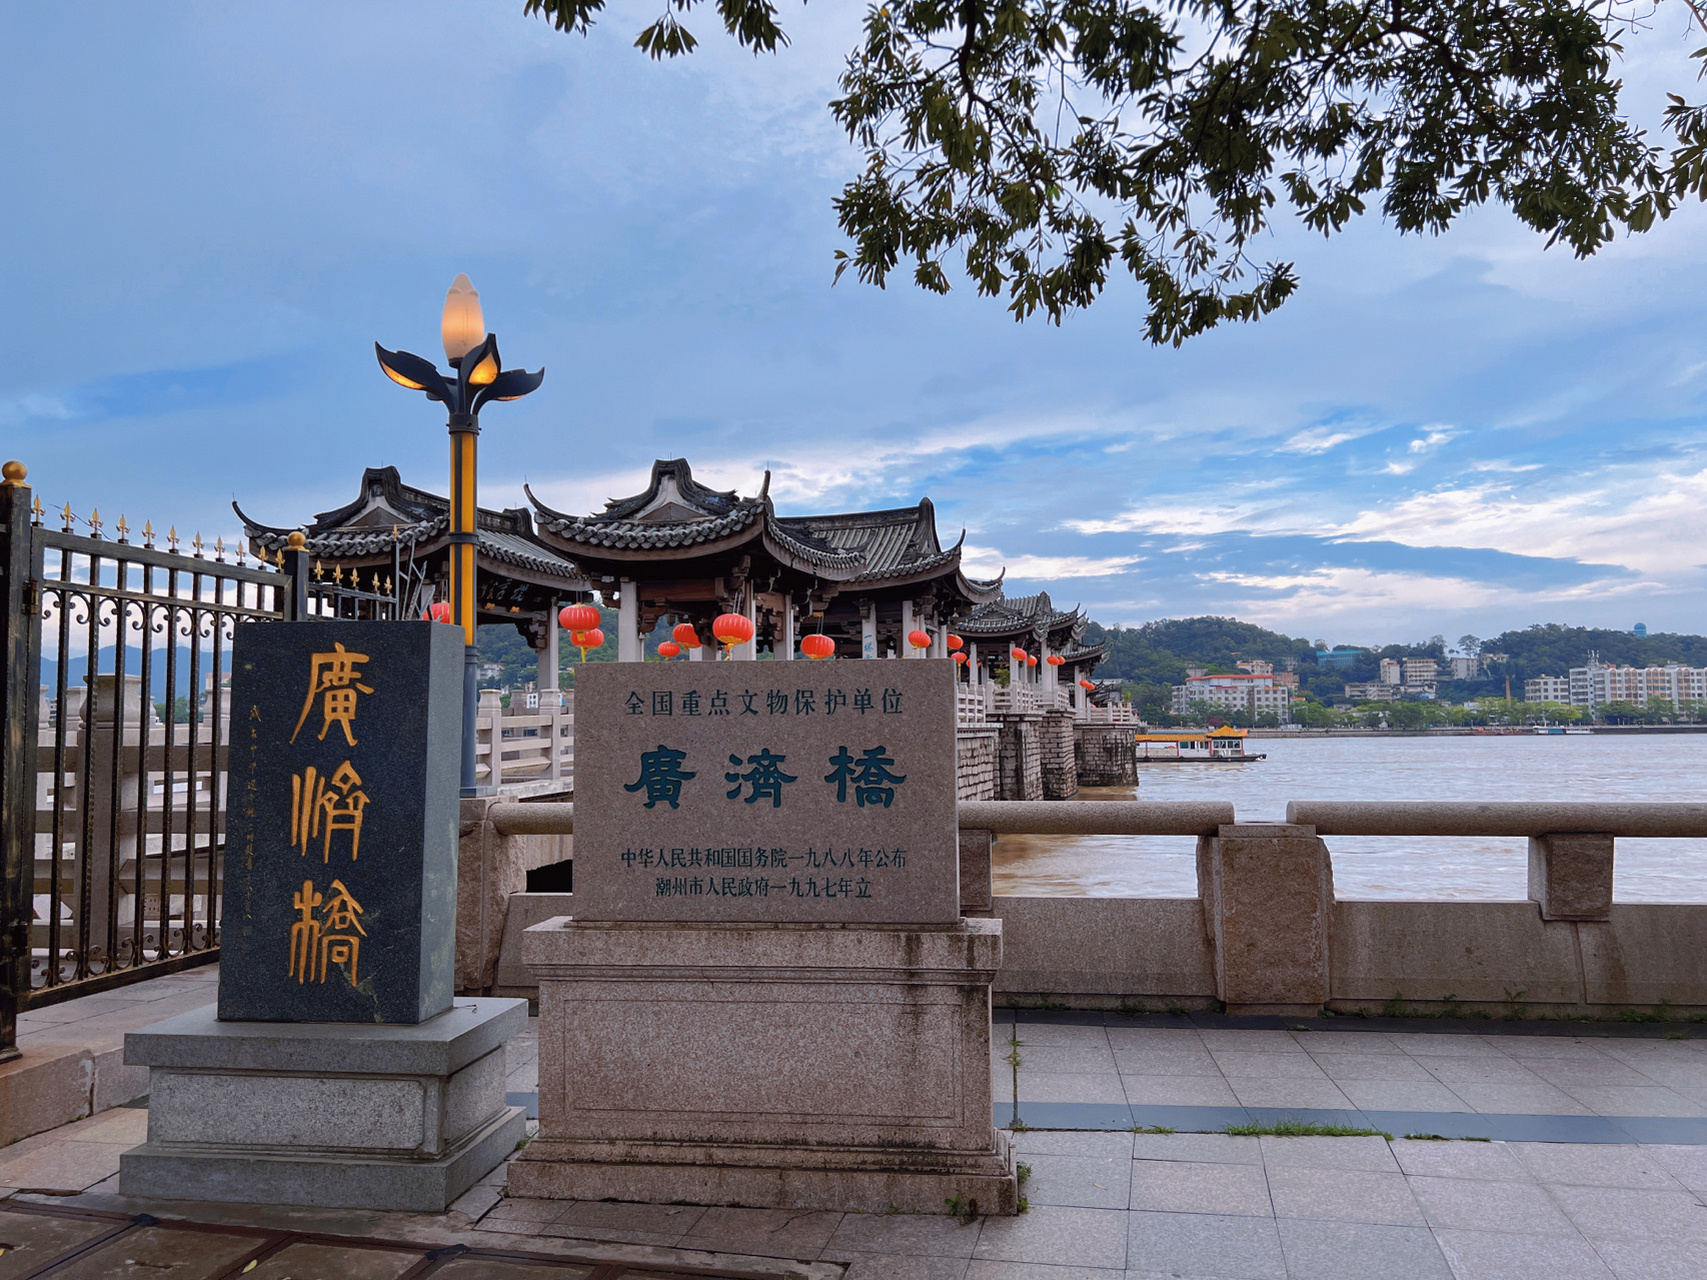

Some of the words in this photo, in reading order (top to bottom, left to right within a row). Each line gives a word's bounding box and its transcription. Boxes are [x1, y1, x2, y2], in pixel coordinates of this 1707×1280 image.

[624, 687, 904, 717] 全国重点文物保护单位
[623, 744, 907, 810] 廣濟橋
[288, 641, 375, 987] 廣濟橋
[620, 847, 907, 869] 中华人民共和国国务院一九八八年公布
[655, 876, 873, 900] 潮州市人民政府一九九七年立
